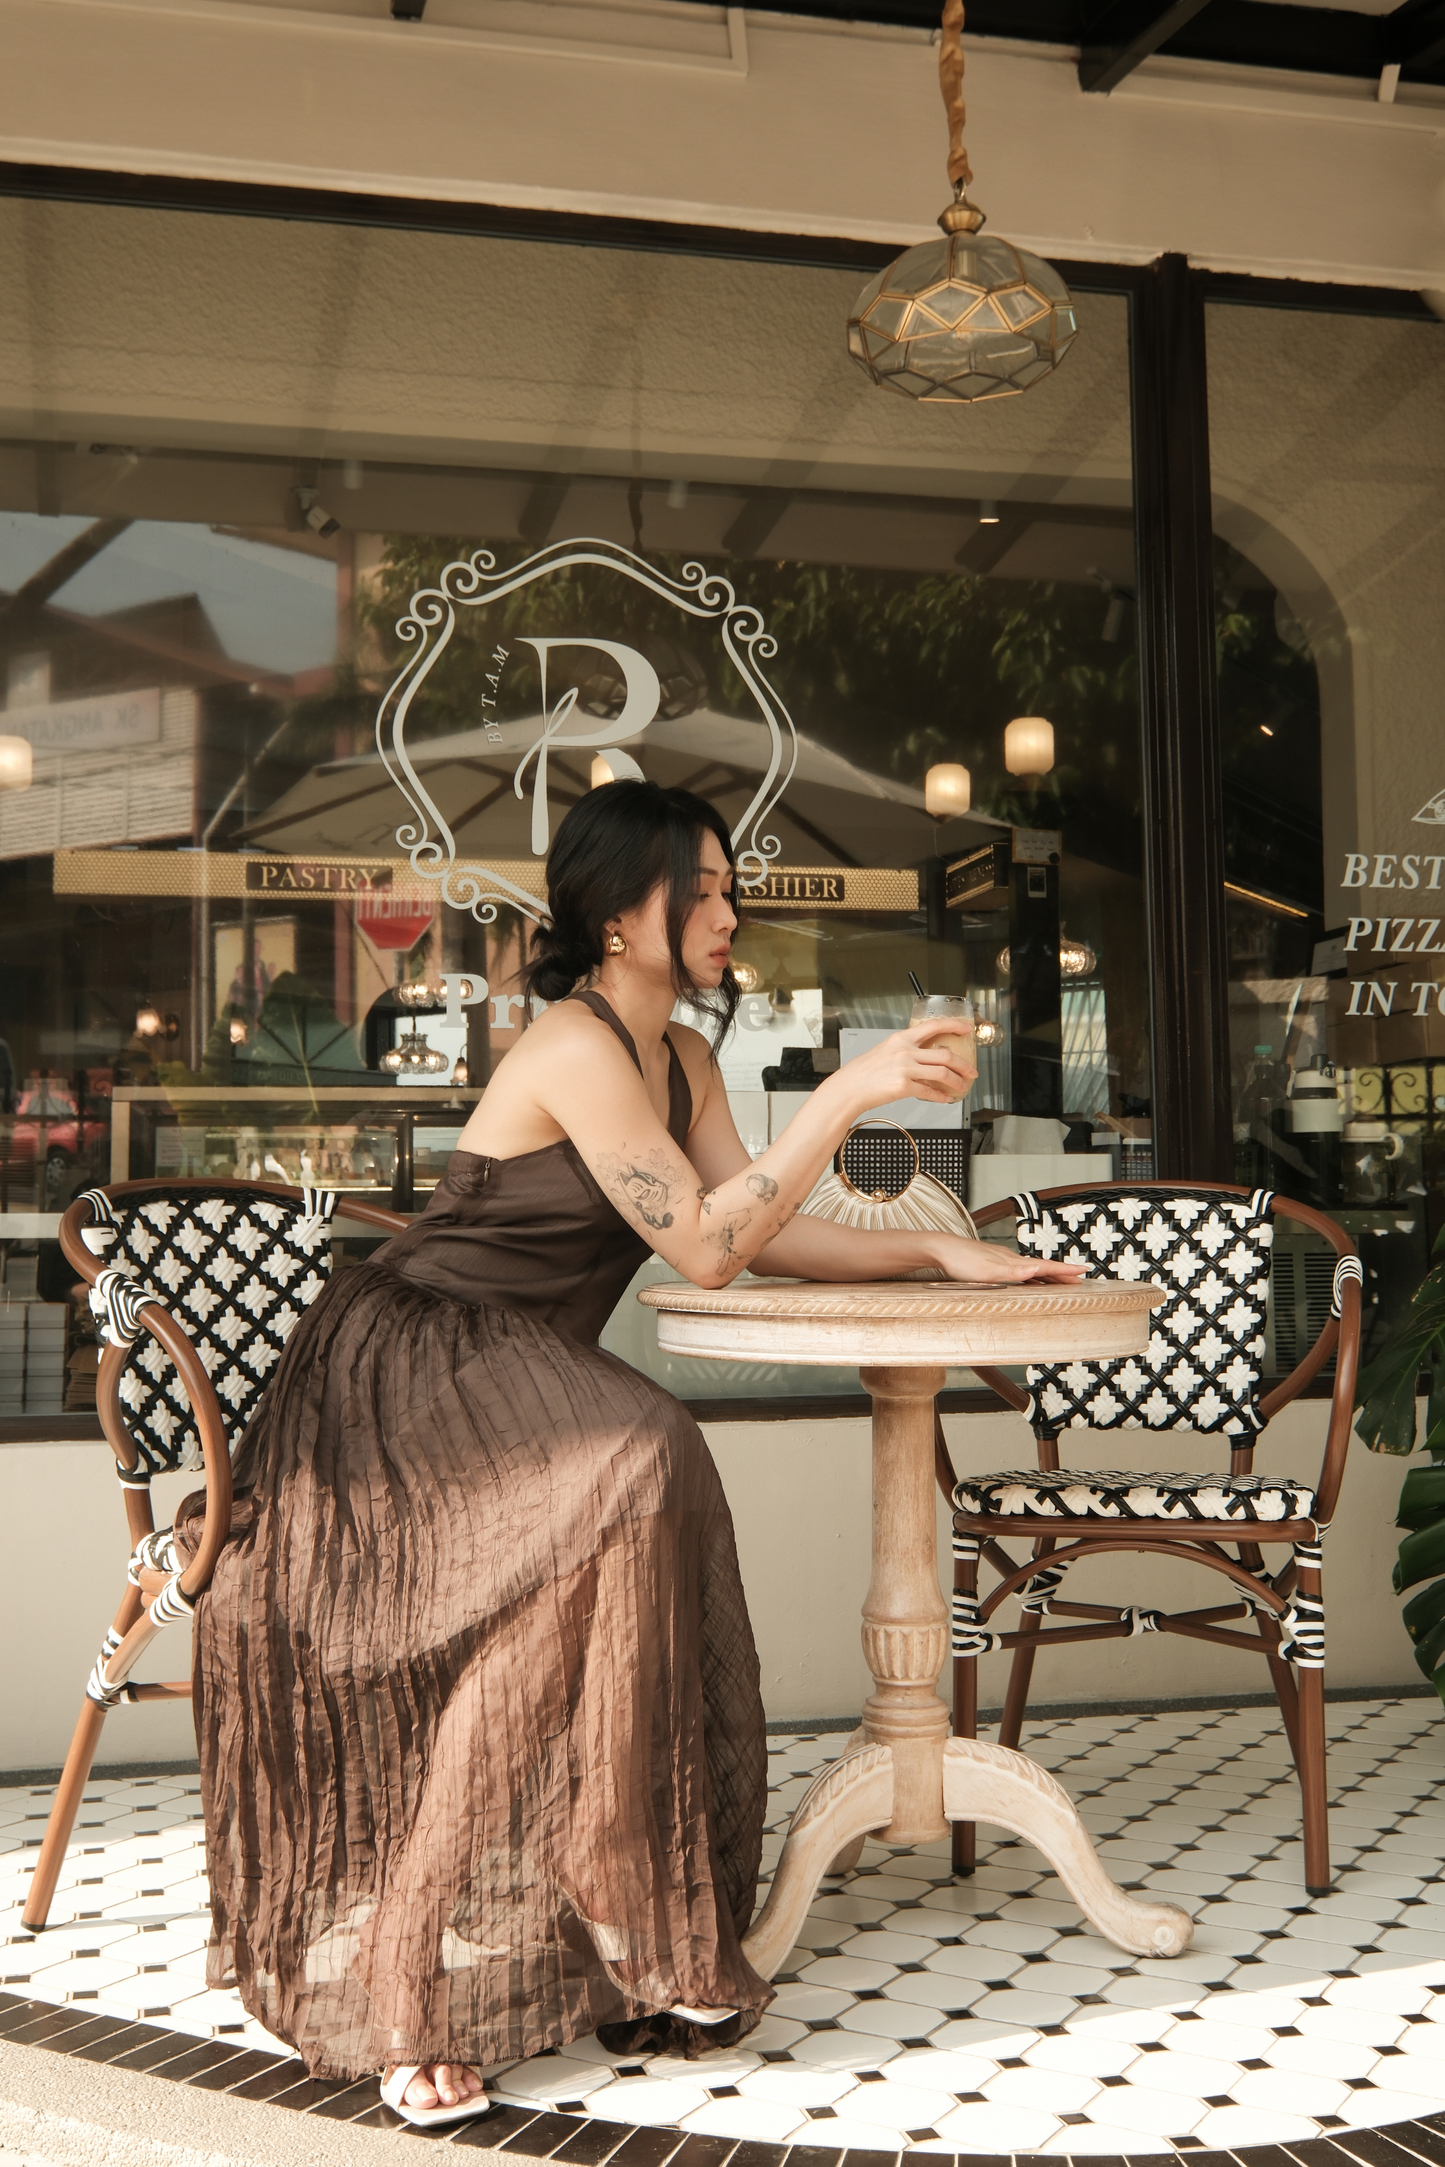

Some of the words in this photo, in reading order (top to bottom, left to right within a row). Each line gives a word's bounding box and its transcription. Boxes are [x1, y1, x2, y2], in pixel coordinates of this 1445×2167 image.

[481, 644, 510, 707] T.A.M
[482, 718, 503, 743] BY
[260, 865, 380, 890] PASTRY
[1340, 853, 1445, 890] BEST
[1343, 917, 1445, 952] PIZZ
[1345, 981, 1398, 1017] IN
[1410, 982, 1445, 1016] T
